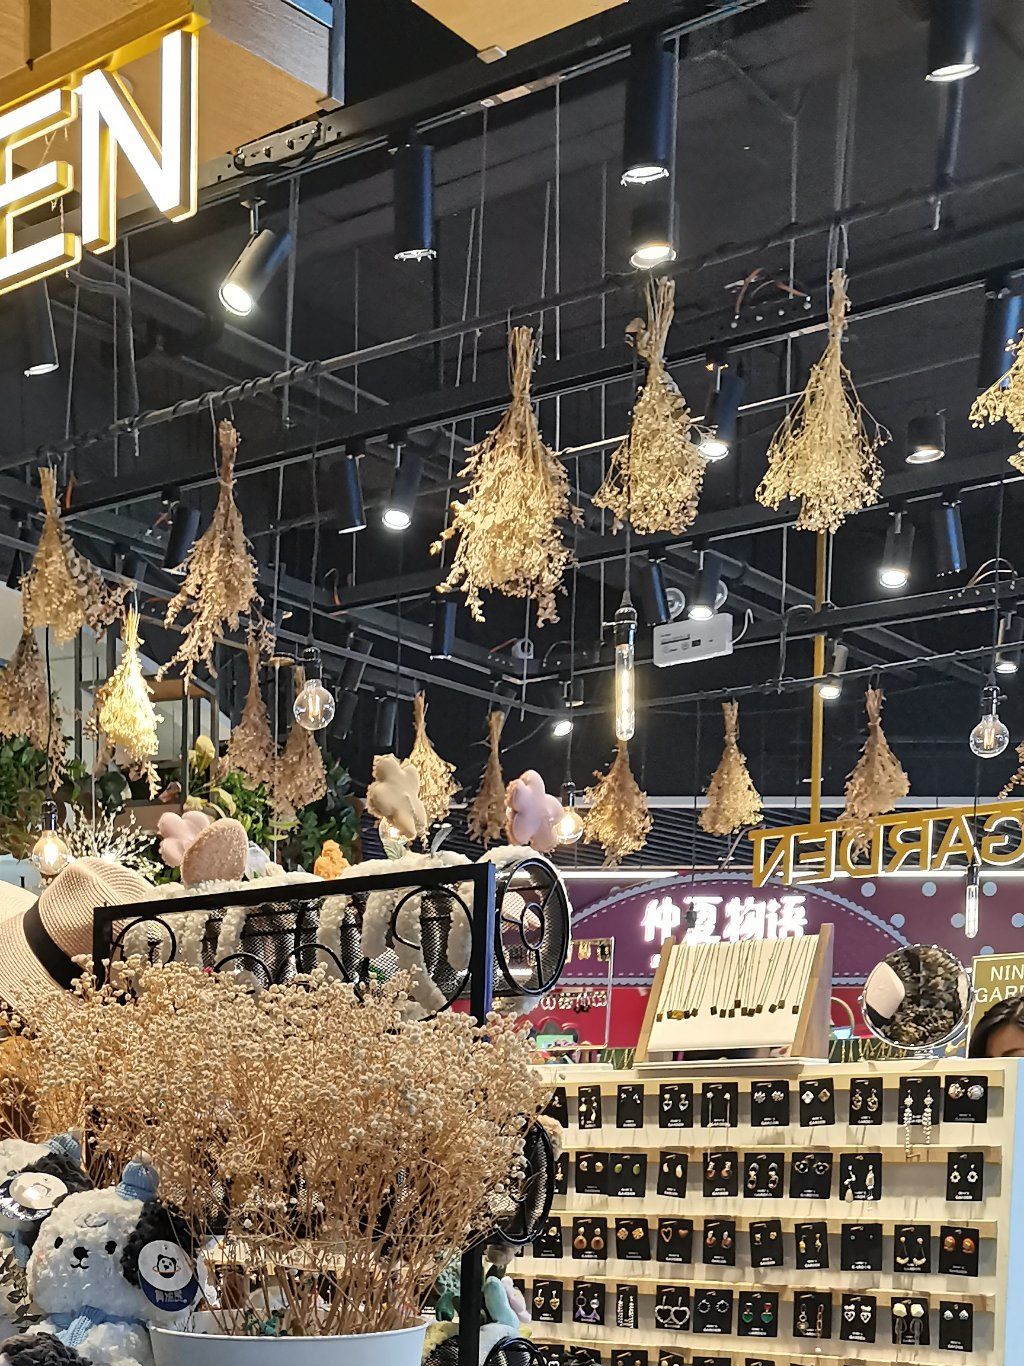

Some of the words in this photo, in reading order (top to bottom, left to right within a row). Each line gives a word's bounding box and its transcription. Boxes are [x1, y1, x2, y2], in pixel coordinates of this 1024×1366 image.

[641, 896, 808, 945] 仲夏物语
[976, 984, 1024, 1003] GAR
